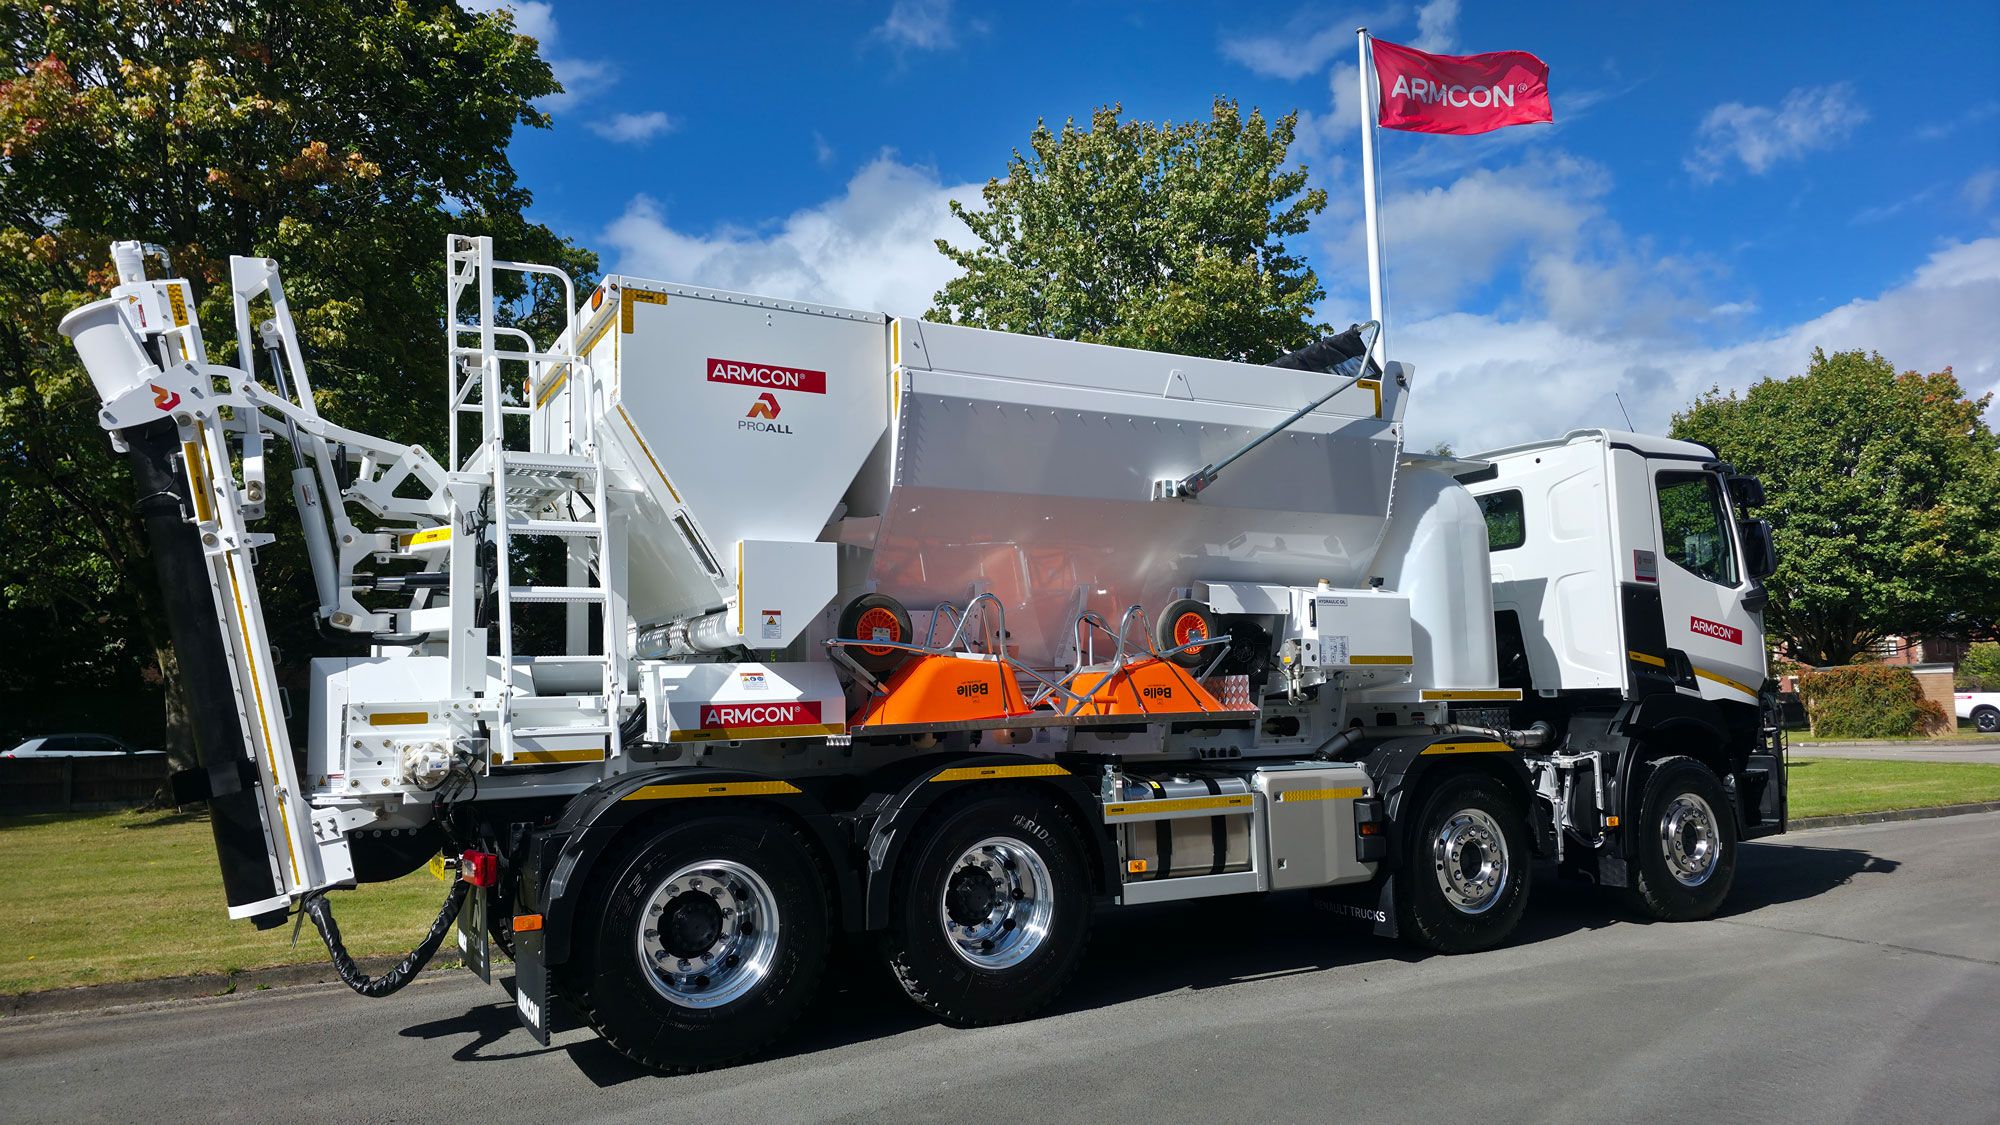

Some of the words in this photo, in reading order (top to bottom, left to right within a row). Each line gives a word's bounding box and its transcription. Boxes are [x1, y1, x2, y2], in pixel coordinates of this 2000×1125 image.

[738, 420, 793, 434] PROALL
[957, 682, 988, 698] Belle
[1143, 687, 1171, 699] Belle
[1351, 906, 1386, 922] TRUCKS
